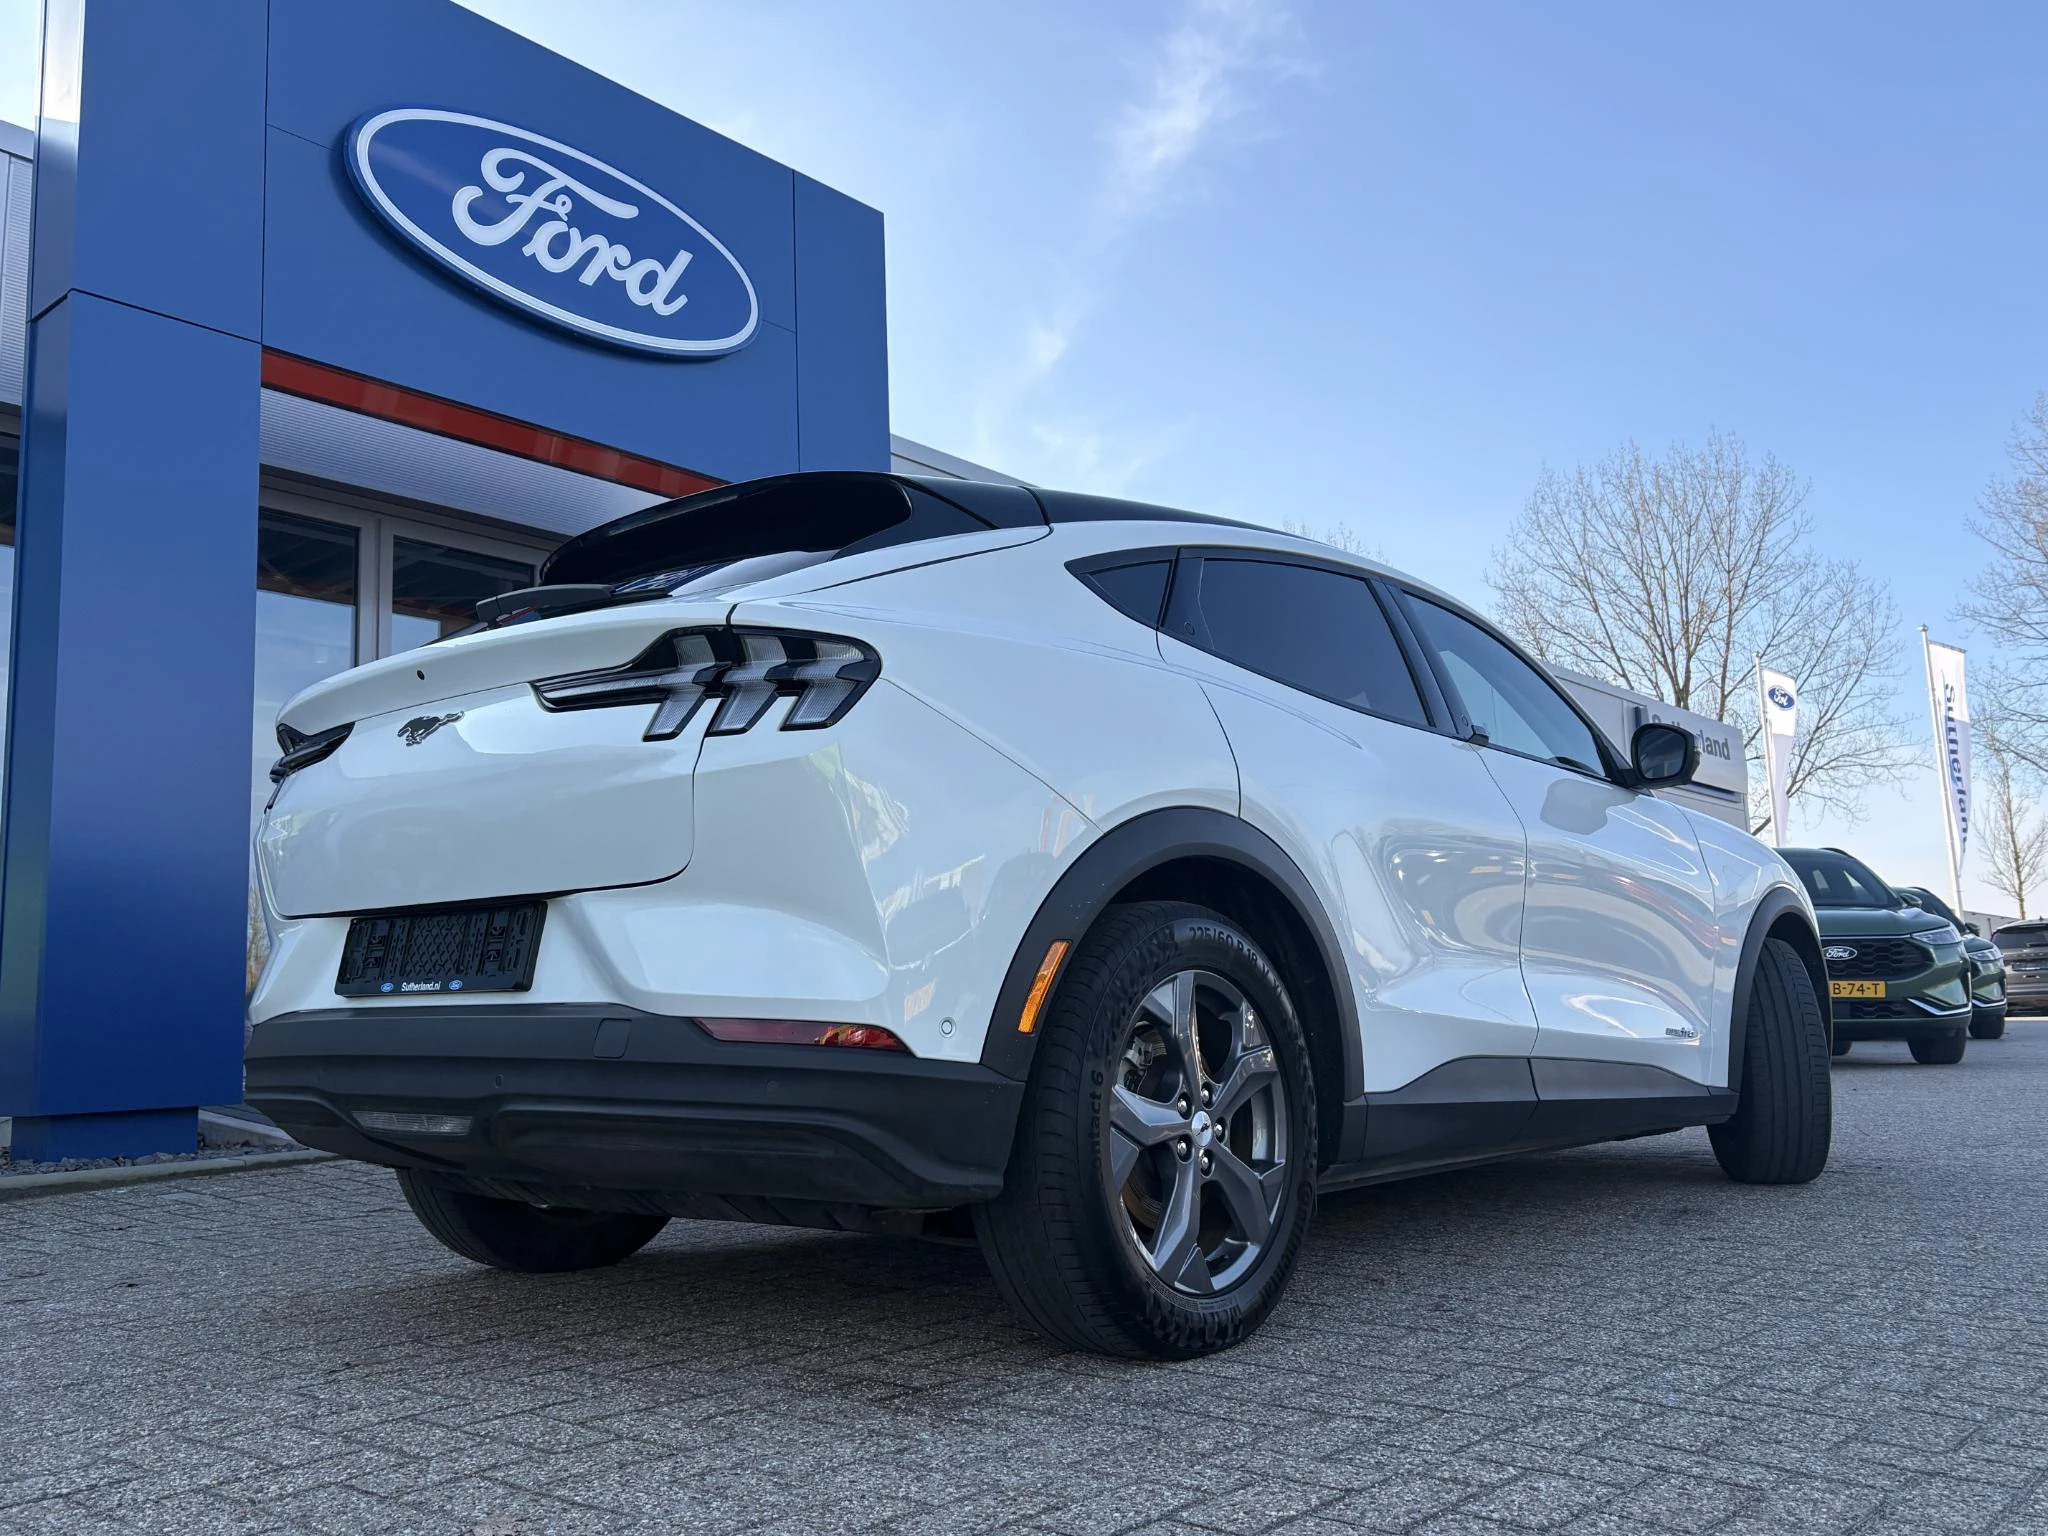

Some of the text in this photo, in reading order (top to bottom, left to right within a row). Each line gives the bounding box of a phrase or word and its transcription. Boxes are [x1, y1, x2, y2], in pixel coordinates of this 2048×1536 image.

[452, 148, 693, 316] Ford
[1826, 948, 1850, 958] Ford
[401, 981, 442, 992] Sutherland.nl
